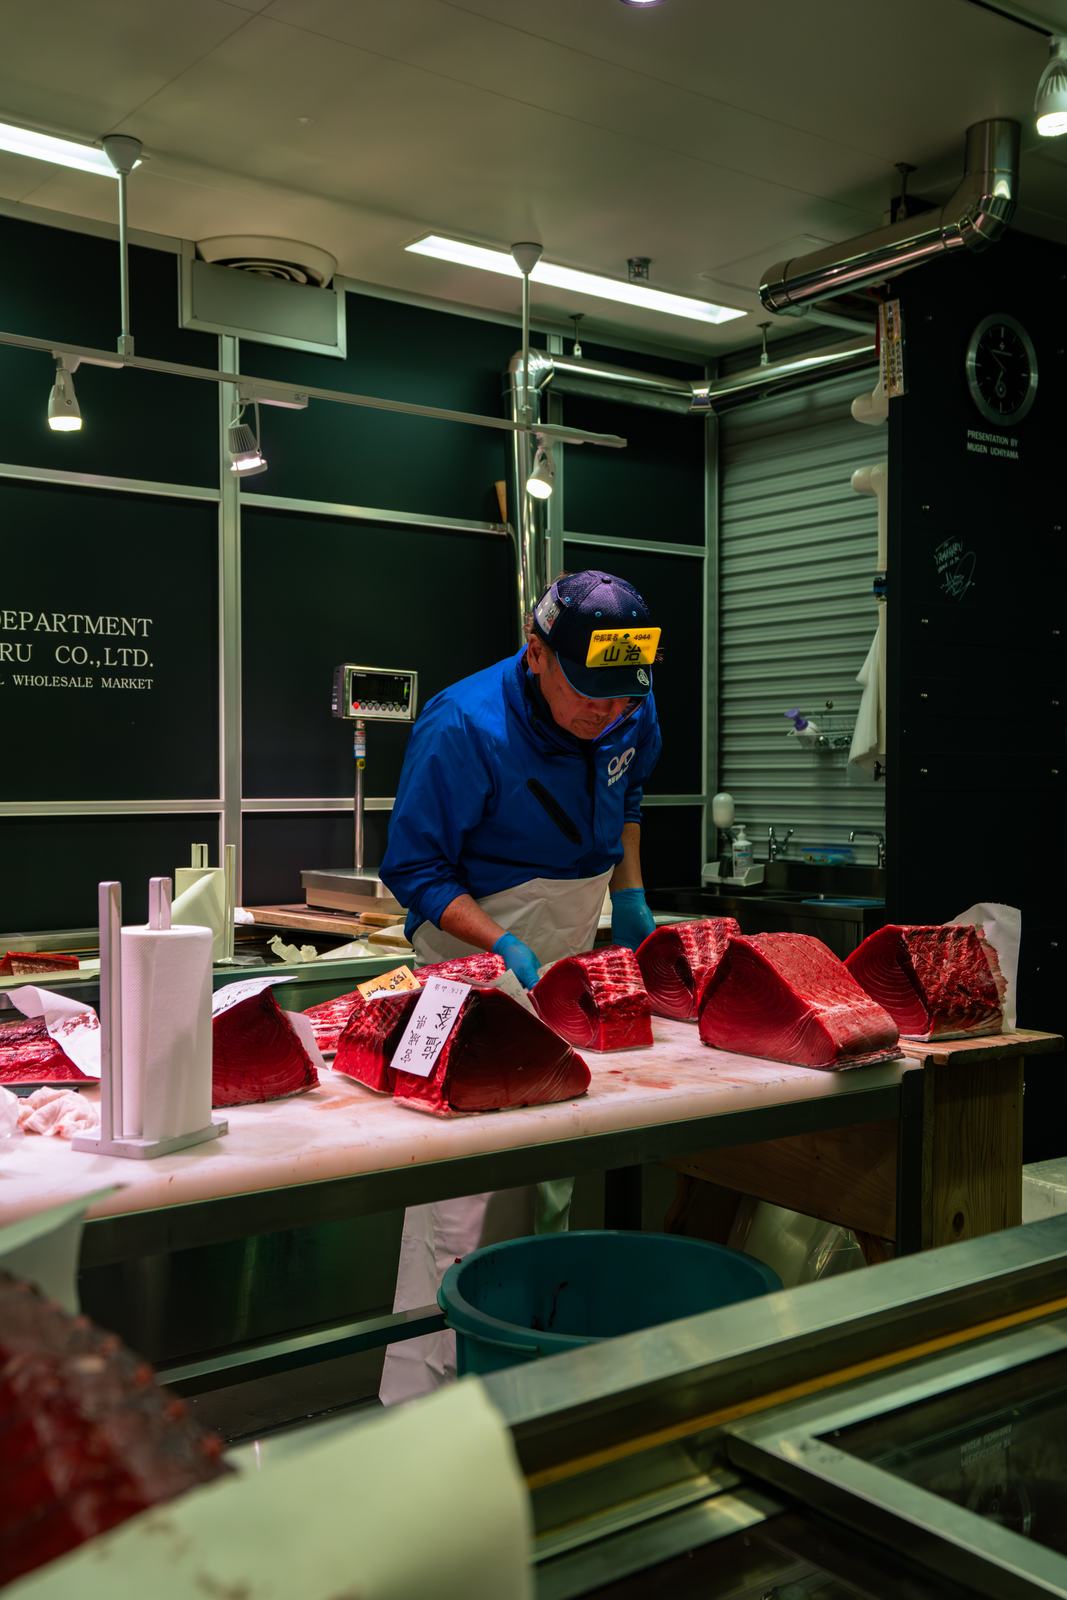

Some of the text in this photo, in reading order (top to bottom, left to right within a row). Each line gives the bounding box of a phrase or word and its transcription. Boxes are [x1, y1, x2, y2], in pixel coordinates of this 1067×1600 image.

[967, 429, 1019, 448] PRESENTATION BY
[967, 442, 1018, 460] MUGEN UCHIYAMA
[0, 610, 153, 637] EPARTMENT
[633, 633, 651, 641] 4944
[55, 645, 154, 668] CO.,LTD.
[603, 645, 642, 662] 山治
[12, 674, 94, 688] WHOLESALE
[101, 677, 154, 690] MARKET
